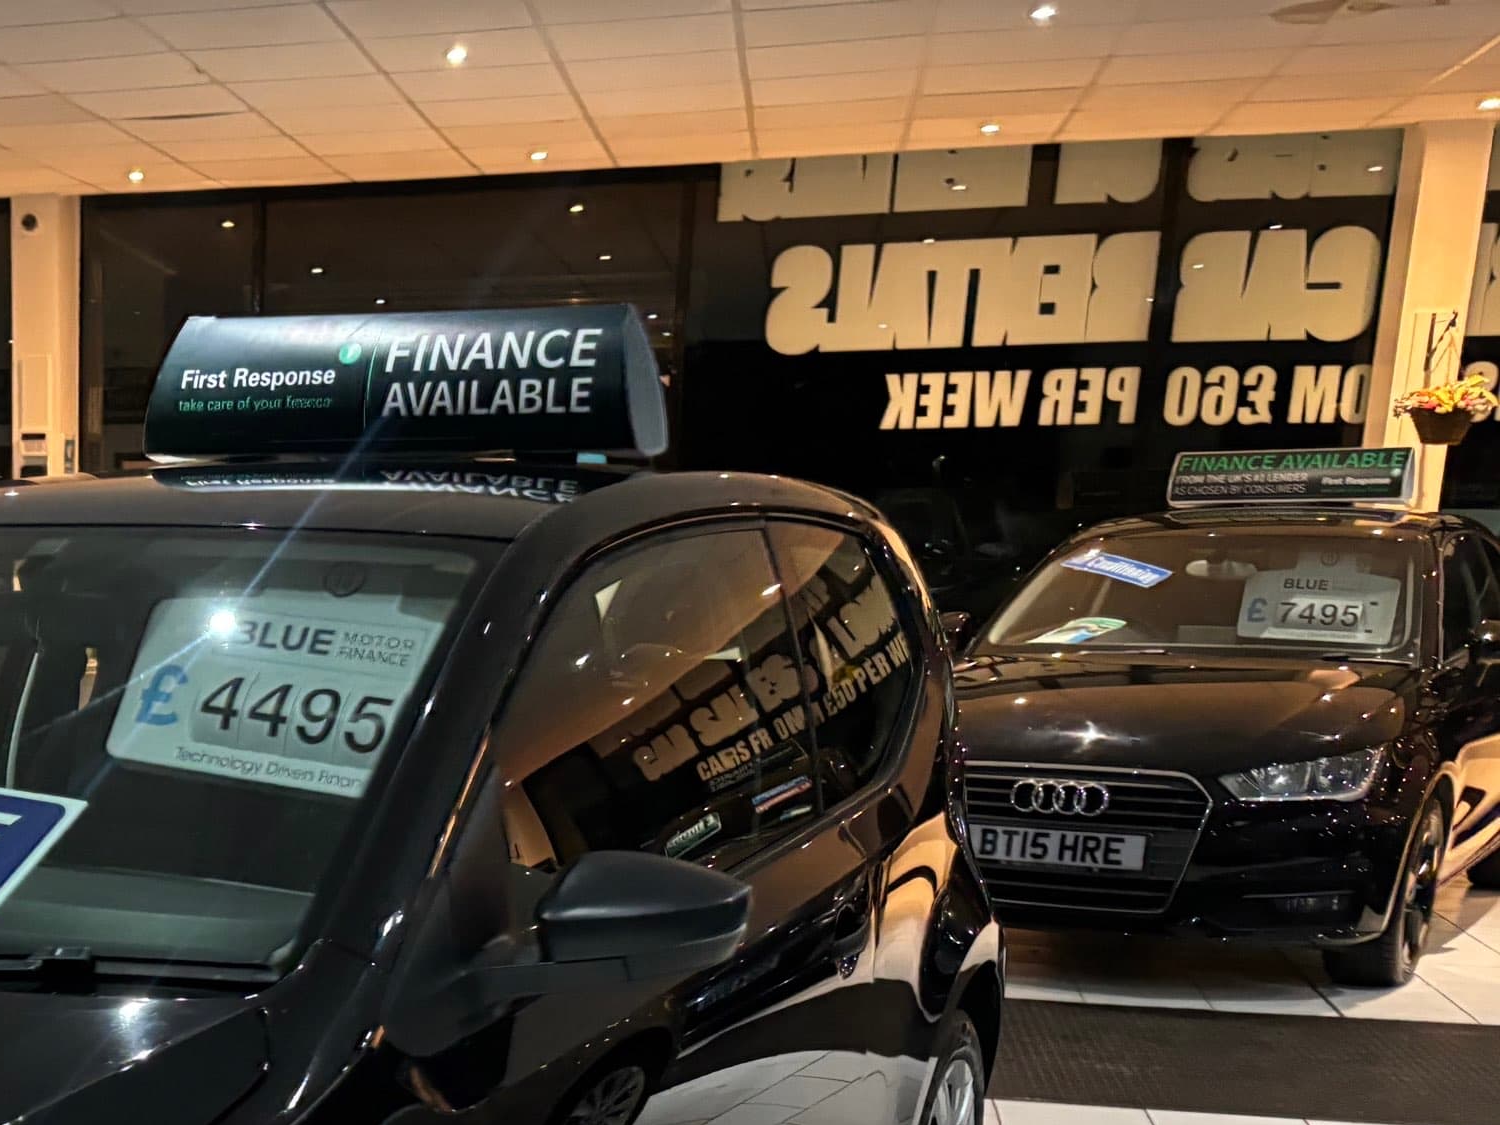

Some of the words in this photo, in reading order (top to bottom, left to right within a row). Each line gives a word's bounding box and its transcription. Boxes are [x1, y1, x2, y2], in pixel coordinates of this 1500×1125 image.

[384, 328, 603, 373] FINANCE
[181, 369, 226, 389] First
[232, 367, 335, 391] Response
[179, 399, 203, 412] take
[207, 399, 233, 411] care
[237, 396, 251, 410] of
[252, 398, 281, 412] your
[381, 377, 593, 417] AVAILABLE
[1179, 455, 1277, 472] FINANCE
[1279, 452, 1407, 469] AVAILABLE
[1172, 485, 1187, 496] AS
[1187, 484, 1229, 496] CHOSEN
[1267, 472, 1309, 483] LENDER
[1283, 578, 1329, 591] BLUE
[1280, 601, 1361, 627] 7495
[235, 621, 336, 655] BLUE
[343, 632, 414, 650] MOTOR
[335, 646, 412, 668] FINANCE
[855, 658, 892, 693] PER
[136, 665, 189, 726] £
[200, 676, 395, 753] 4495
[175, 745, 263, 776] Technology
[265, 760, 315, 783] Driven
[979, 829, 1051, 860] BT15
[1058, 834, 1125, 866] HRE
